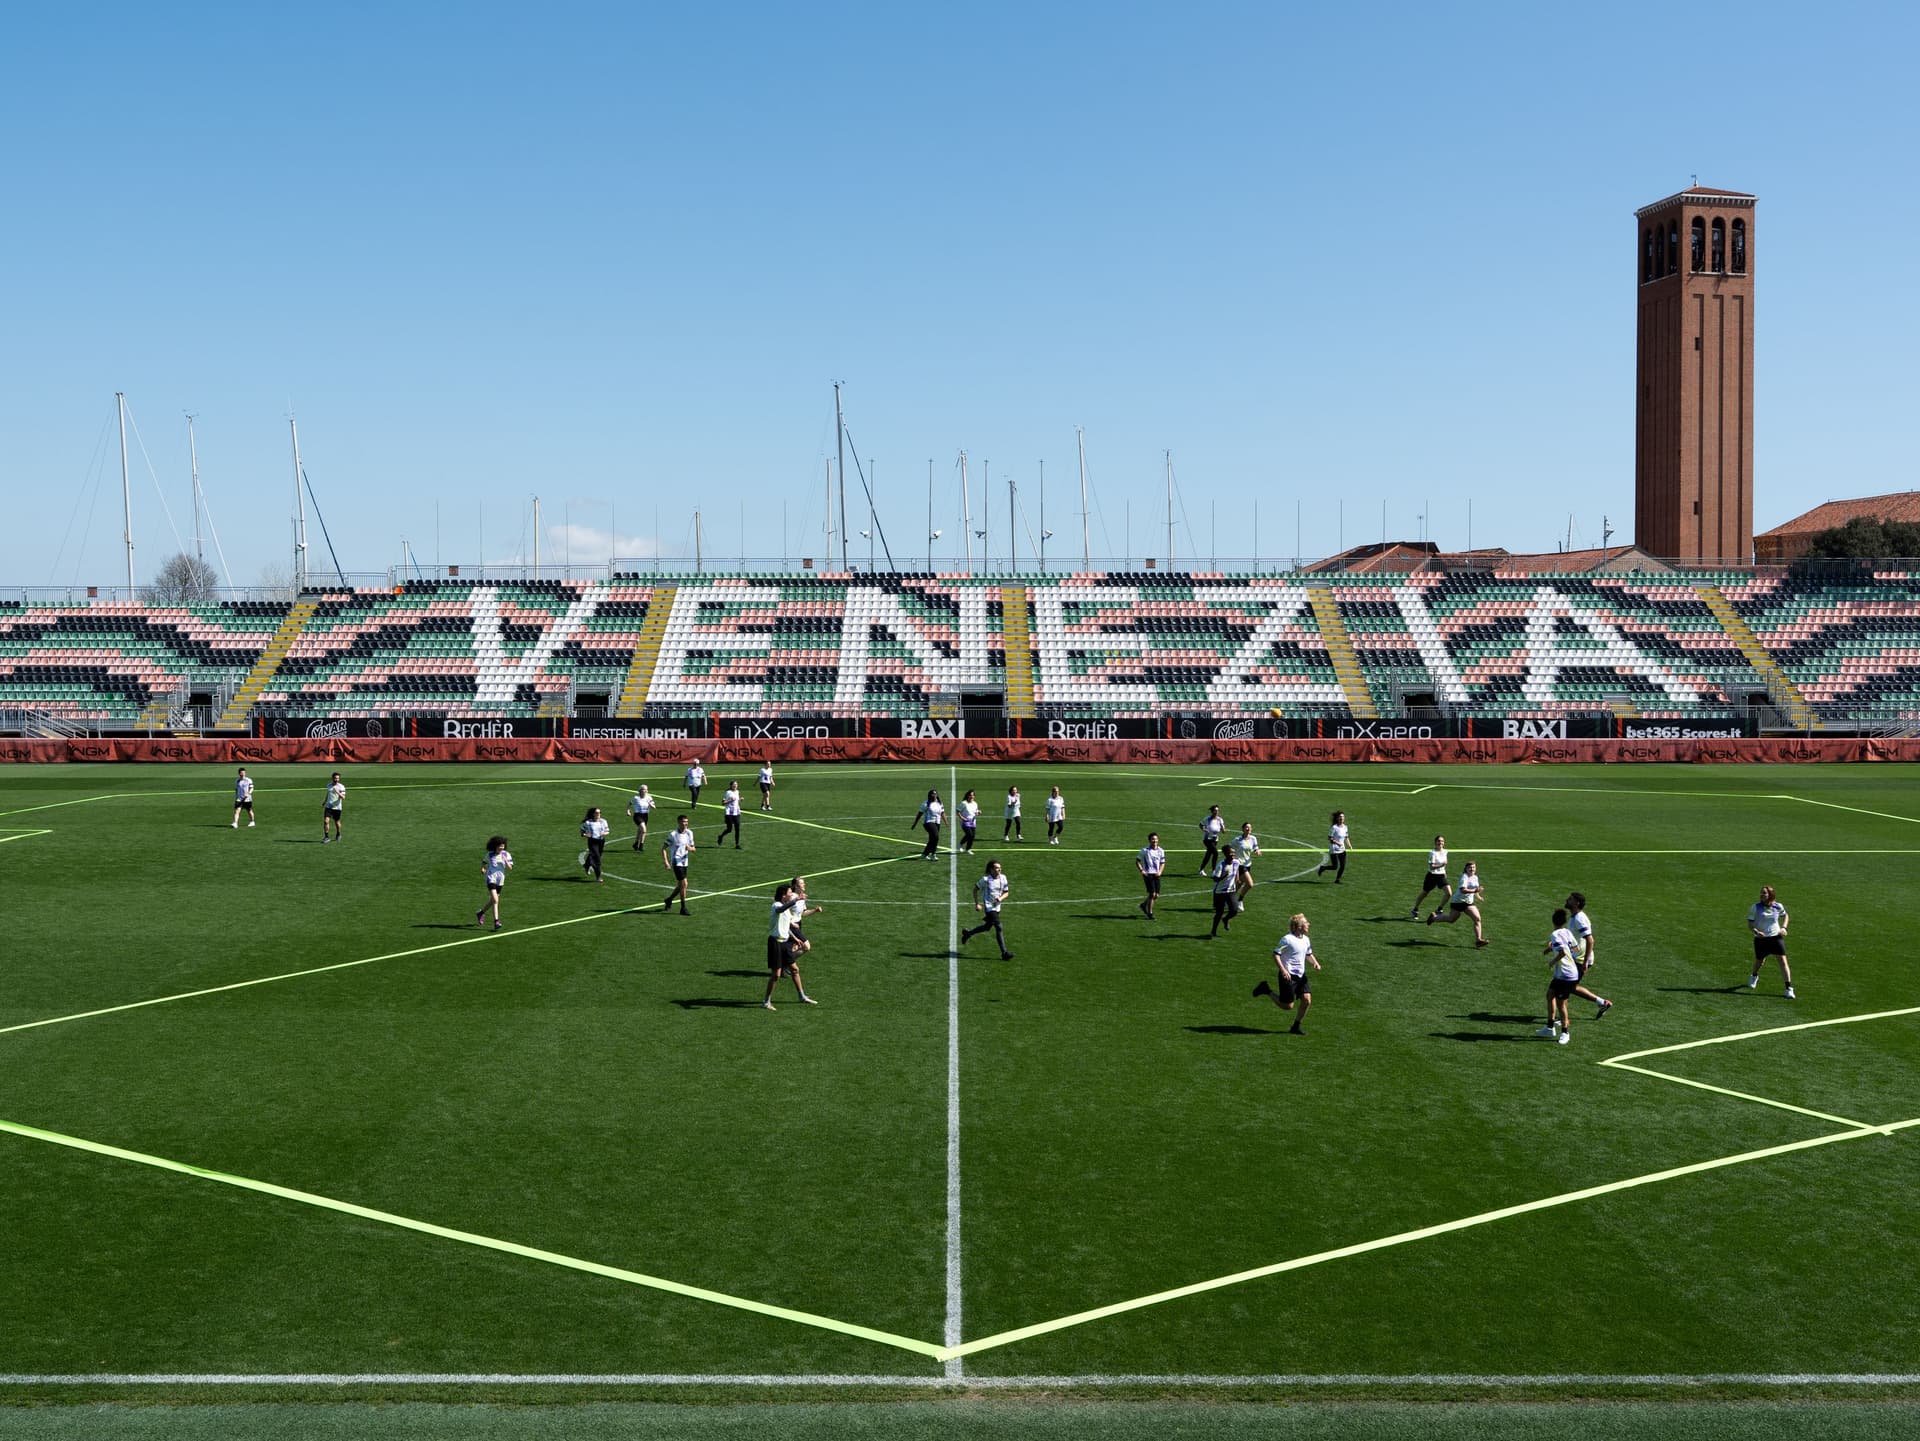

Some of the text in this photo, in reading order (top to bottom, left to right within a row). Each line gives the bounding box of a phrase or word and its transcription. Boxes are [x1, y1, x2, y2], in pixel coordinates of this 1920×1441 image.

[470, 586, 1700, 702] VENEZIA
[306, 719, 347, 738] CYNAR
[573, 728, 688, 738] FINESTRE NURITH
[901, 719, 965, 738] BAXI
[1214, 719, 1254, 739] CYNAR
[1503, 719, 1567, 738] BAXI
[1626, 725, 1680, 738] bet365
[74, 746, 110, 757] NGM
[156, 747, 193, 758] NGM
[236, 747, 272, 758] NGM
[398, 747, 434, 757] NGM
[481, 747, 518, 757] NGM
[564, 748, 599, 758] NGM
[726, 747, 762, 757] NGM
[810, 746, 846, 756] NGM
[888, 747, 926, 757] NGM
[972, 747, 1009, 757] NGM
[1054, 747, 1089, 758] NGM
[1136, 748, 1173, 759] NGM
[1217, 746, 1253, 756] NGM
[1299, 747, 1335, 758] NGM
[1460, 749, 1497, 760] NGM
[1540, 748, 1577, 759] NGM
[1623, 748, 1660, 758] NGM
[1701, 749, 1738, 759] NGM
[1785, 749, 1821, 759] NGM
